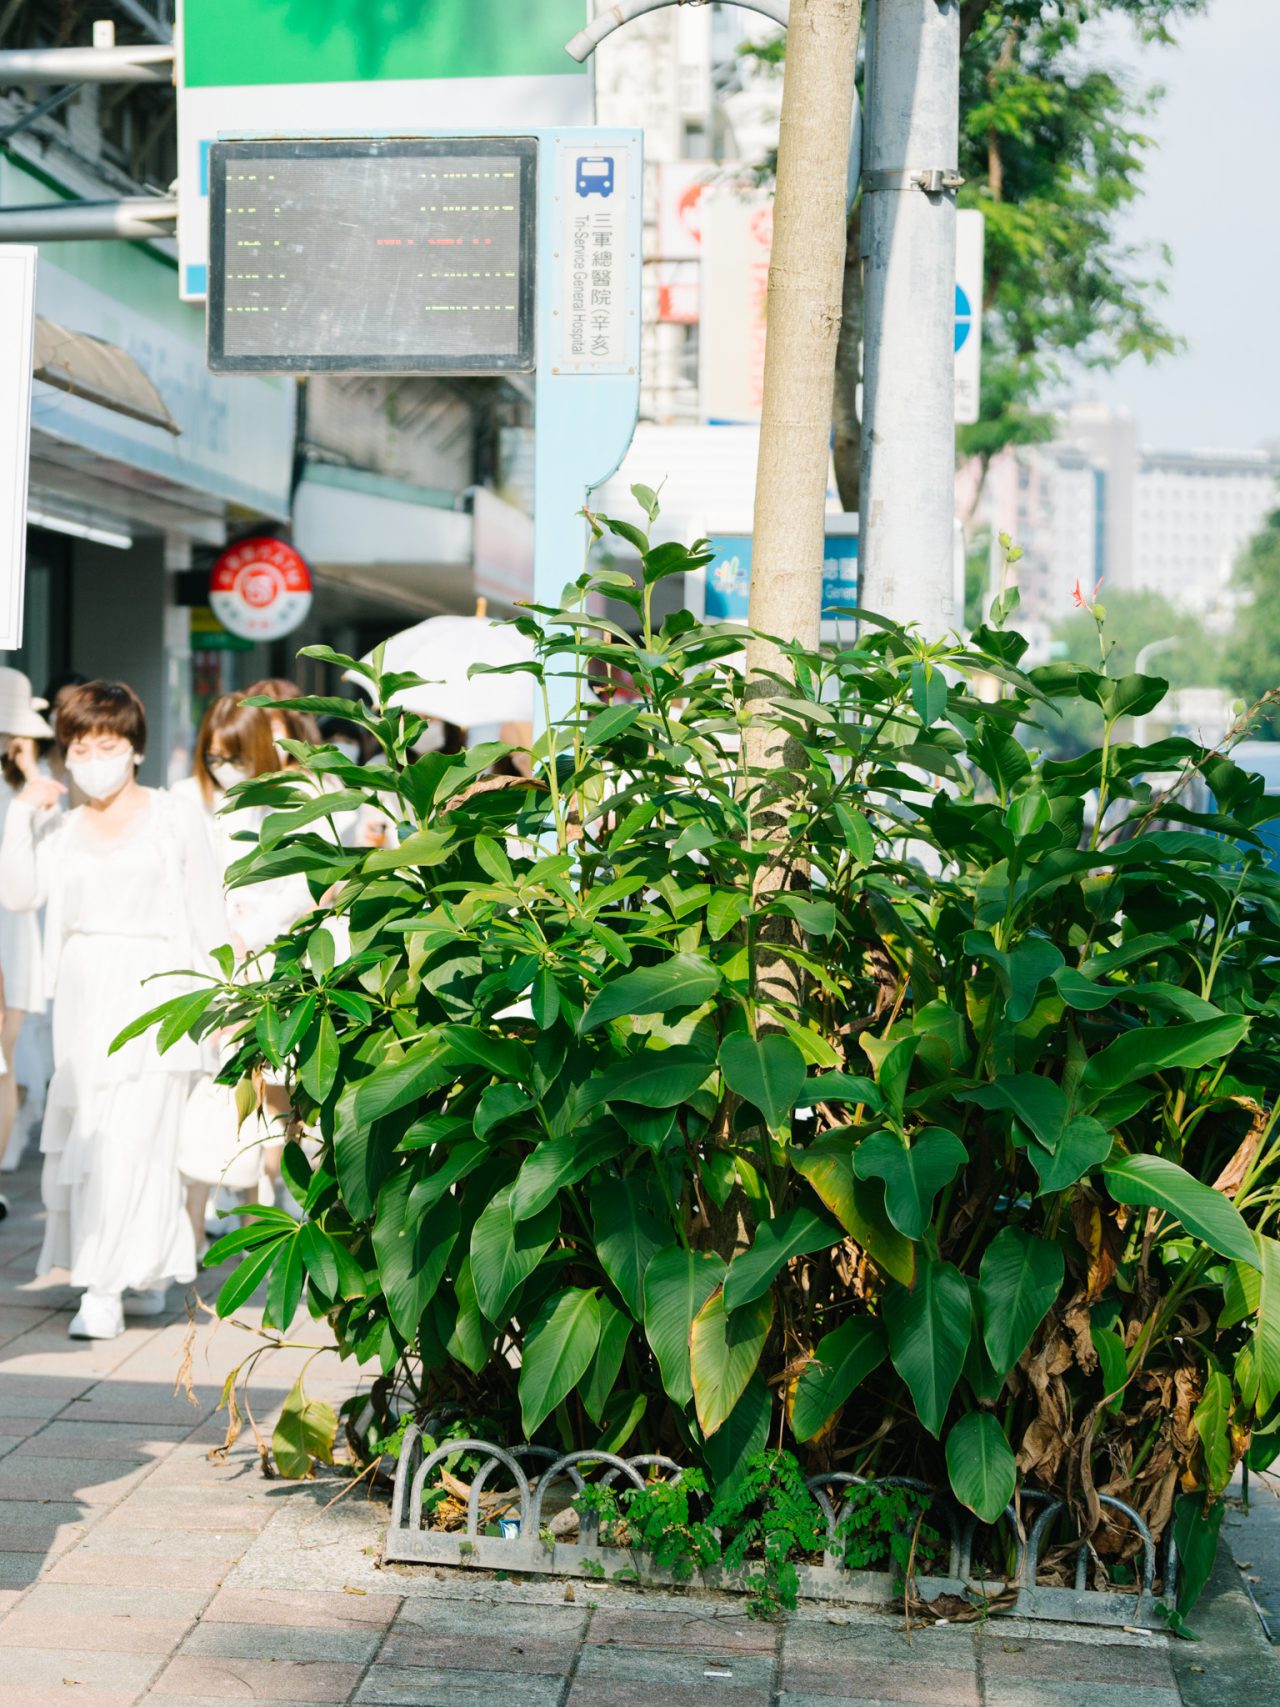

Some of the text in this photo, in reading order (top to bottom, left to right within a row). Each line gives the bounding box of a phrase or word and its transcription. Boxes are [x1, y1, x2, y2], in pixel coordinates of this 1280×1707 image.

[570, 215, 589, 355] Tri-Service General Hospital
